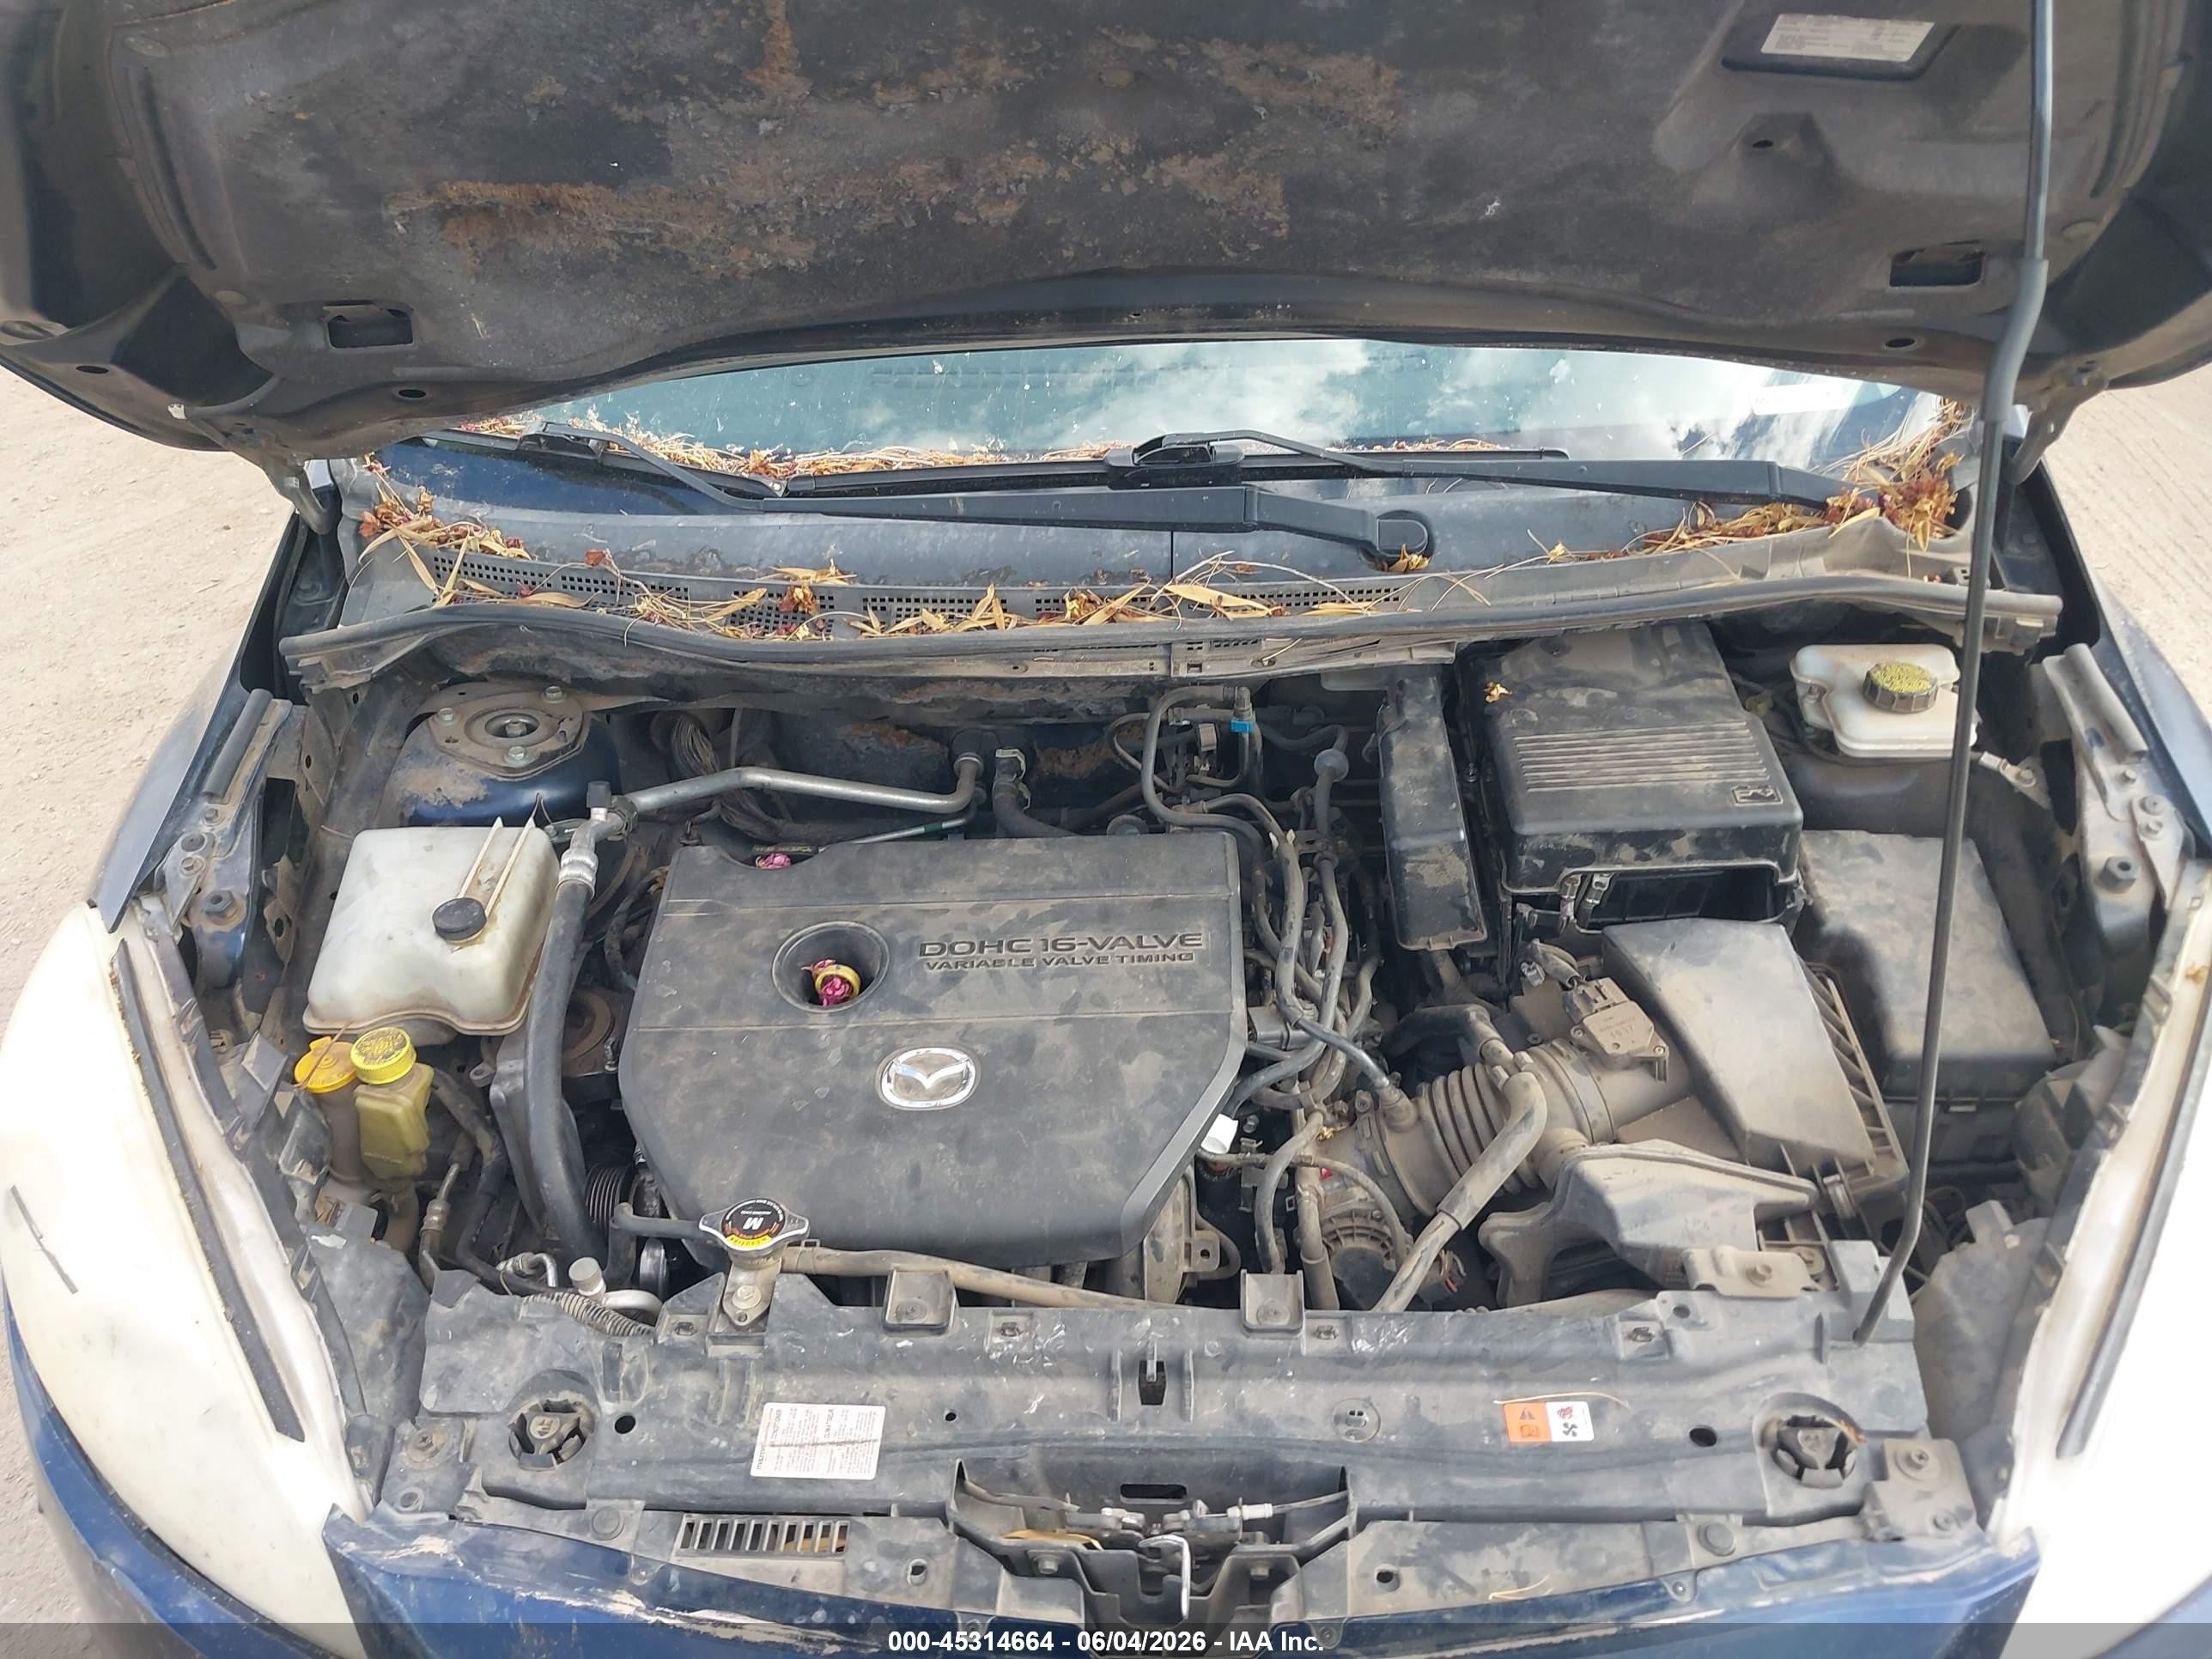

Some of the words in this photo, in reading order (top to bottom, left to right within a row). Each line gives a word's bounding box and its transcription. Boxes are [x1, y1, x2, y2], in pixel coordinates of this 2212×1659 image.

[920, 939, 1031, 957] DOHC
[1040, 933, 1202, 952] 16-VALVE
[926, 957, 1036, 969] VARIABLE
[1042, 955, 1109, 966] VALVE
[1115, 952, 1194, 963] TIMING
